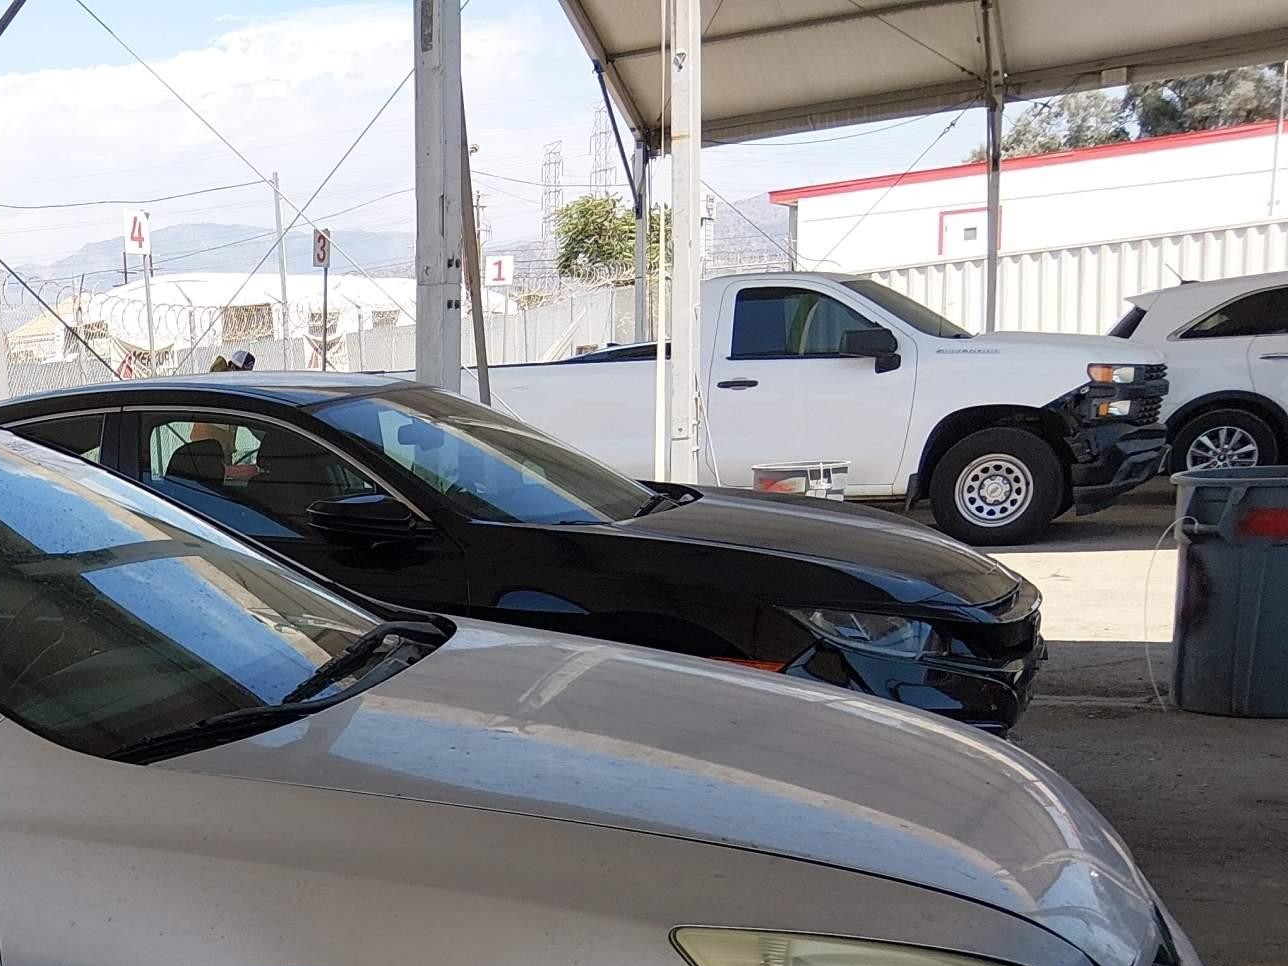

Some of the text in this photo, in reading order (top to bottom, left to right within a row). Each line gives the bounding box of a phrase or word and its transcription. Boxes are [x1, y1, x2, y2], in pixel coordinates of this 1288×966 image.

[130, 216, 145, 248] 4
[316, 236, 326, 263] 3
[493, 260, 505, 281] 1
